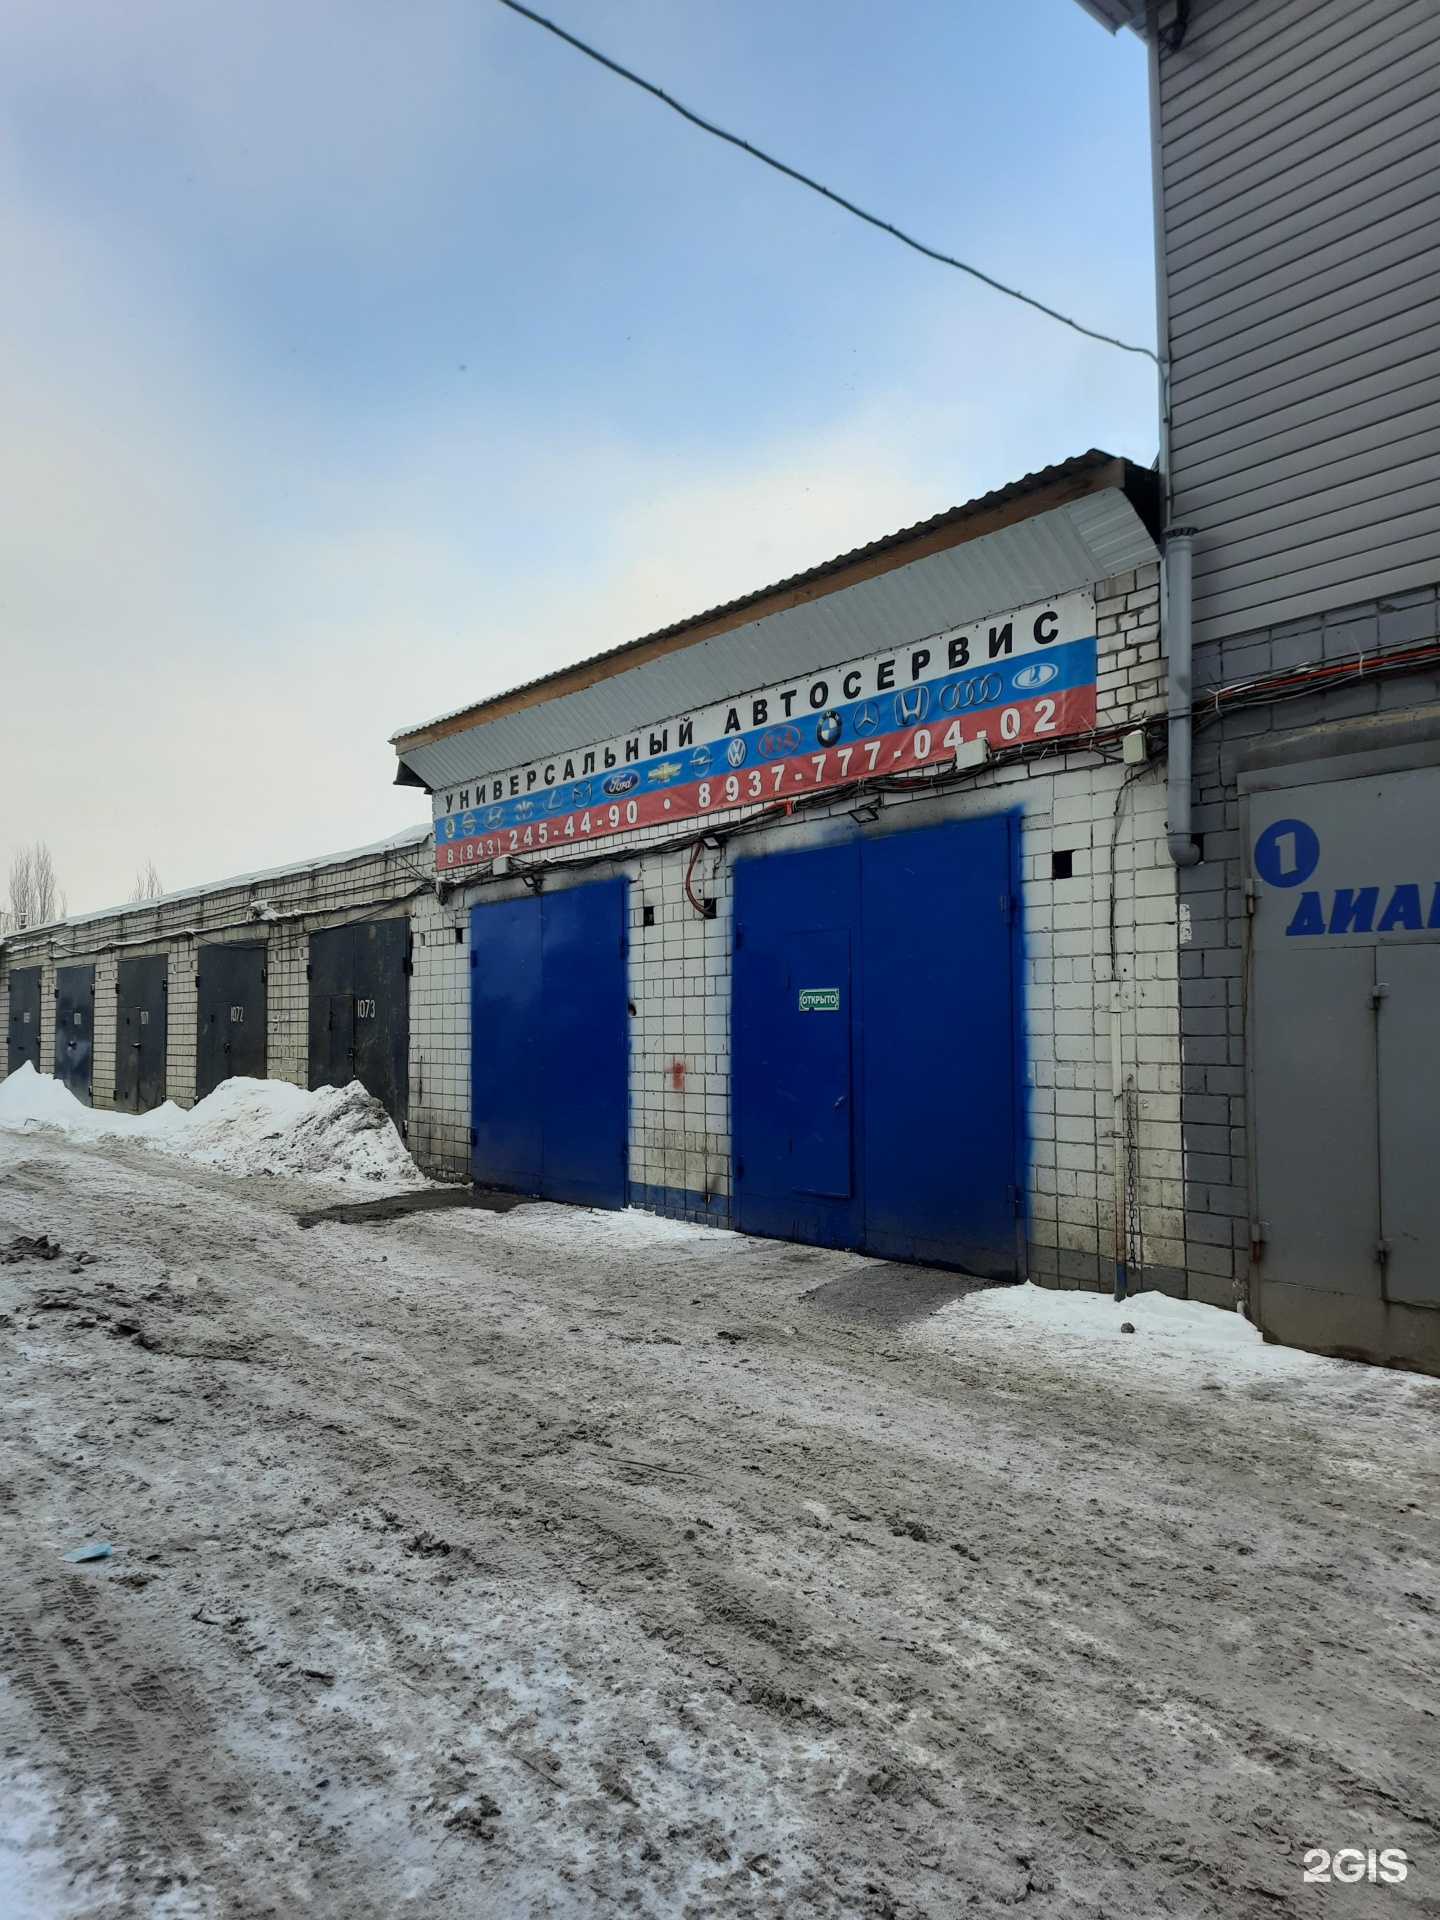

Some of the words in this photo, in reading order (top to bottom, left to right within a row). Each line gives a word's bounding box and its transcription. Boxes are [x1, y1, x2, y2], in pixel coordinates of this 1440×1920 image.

[446, 717, 694, 814] УНИВЕРСАЛЬНЫЙ
[724, 611, 1060, 735] АВТОСЕРВИС
[508, 800, 639, 850] 245-44-90
[1274, 831, 1301, 876] 1
[356, 999, 376, 1019] 1073
[802, 995, 836, 1005] ОТКРЫТО
